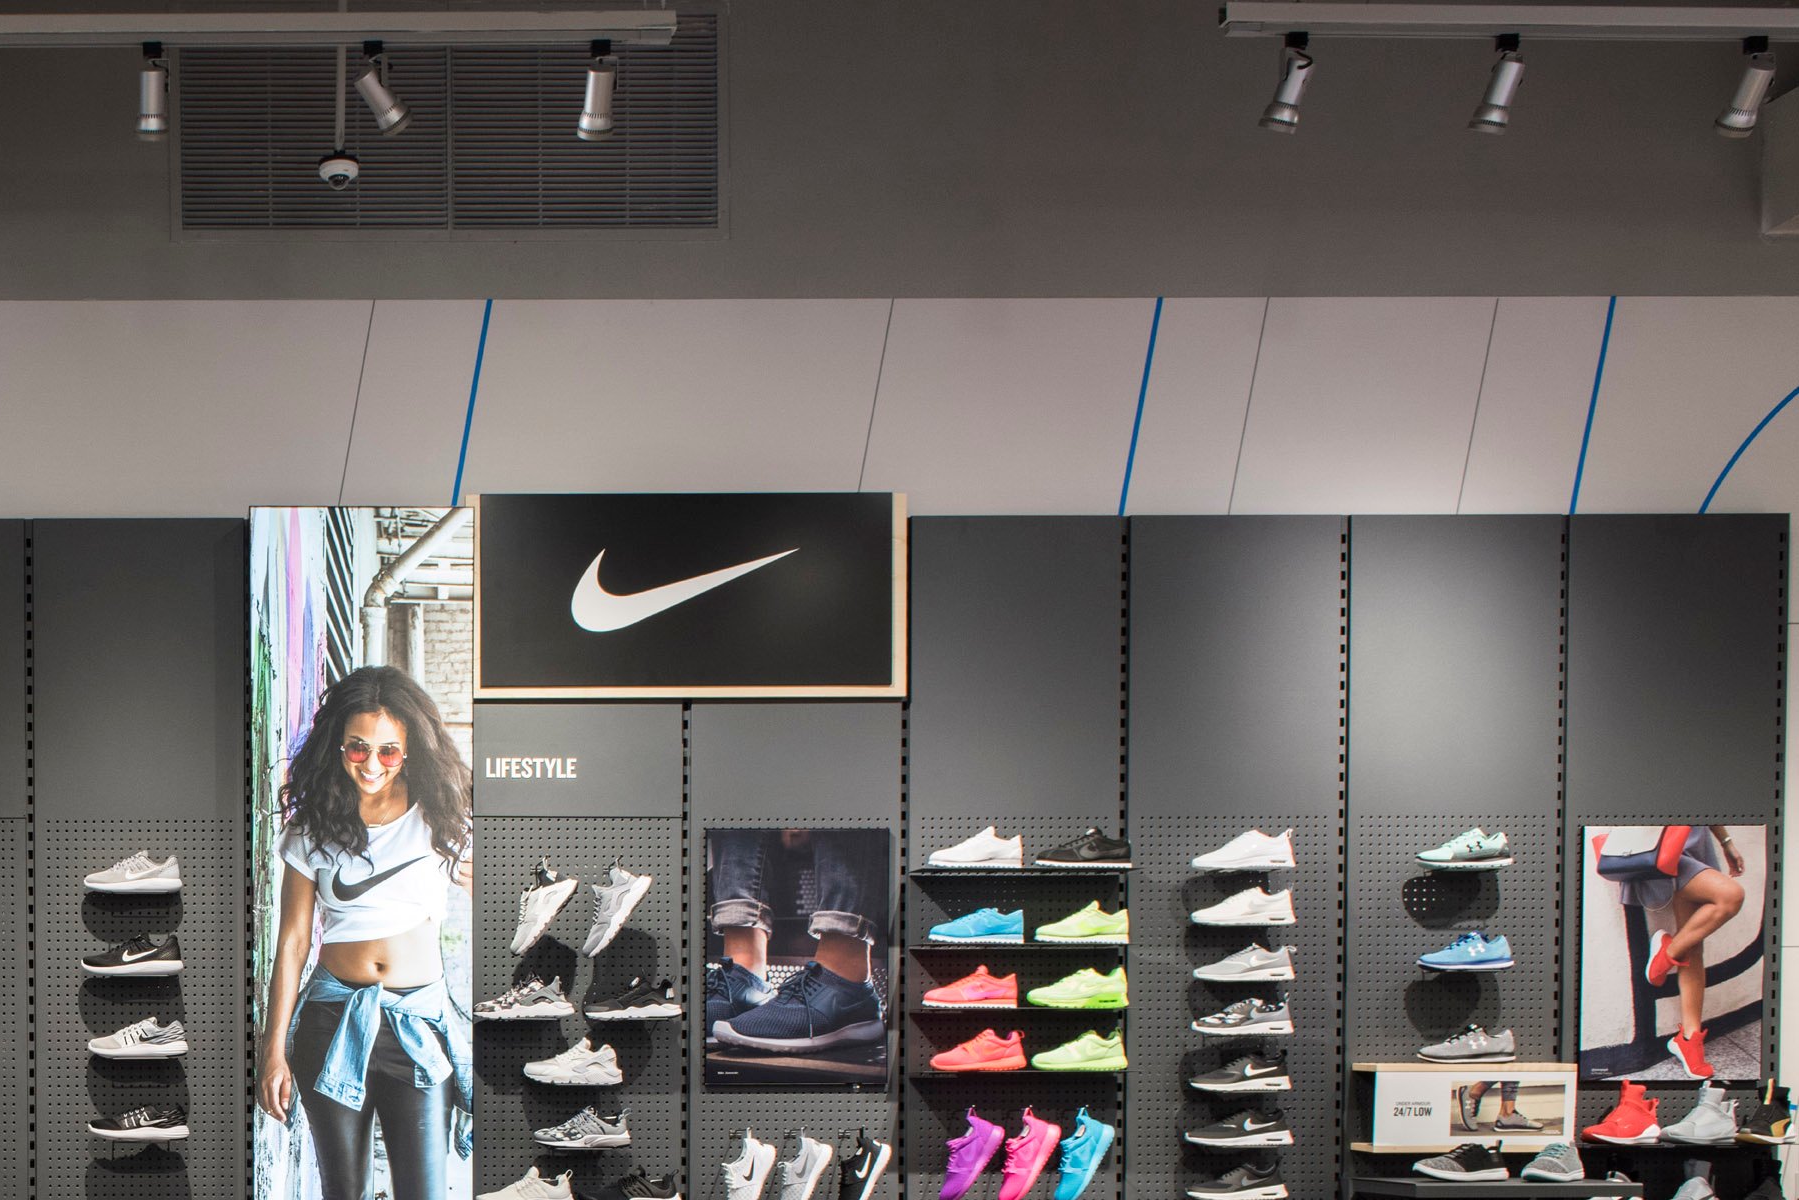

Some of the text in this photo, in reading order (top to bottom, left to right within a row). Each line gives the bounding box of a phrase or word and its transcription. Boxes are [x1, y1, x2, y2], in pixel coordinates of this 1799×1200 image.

[485, 757, 577, 778] LIFESTYLE
[1393, 1106, 1432, 1117] 24/7 LOW
